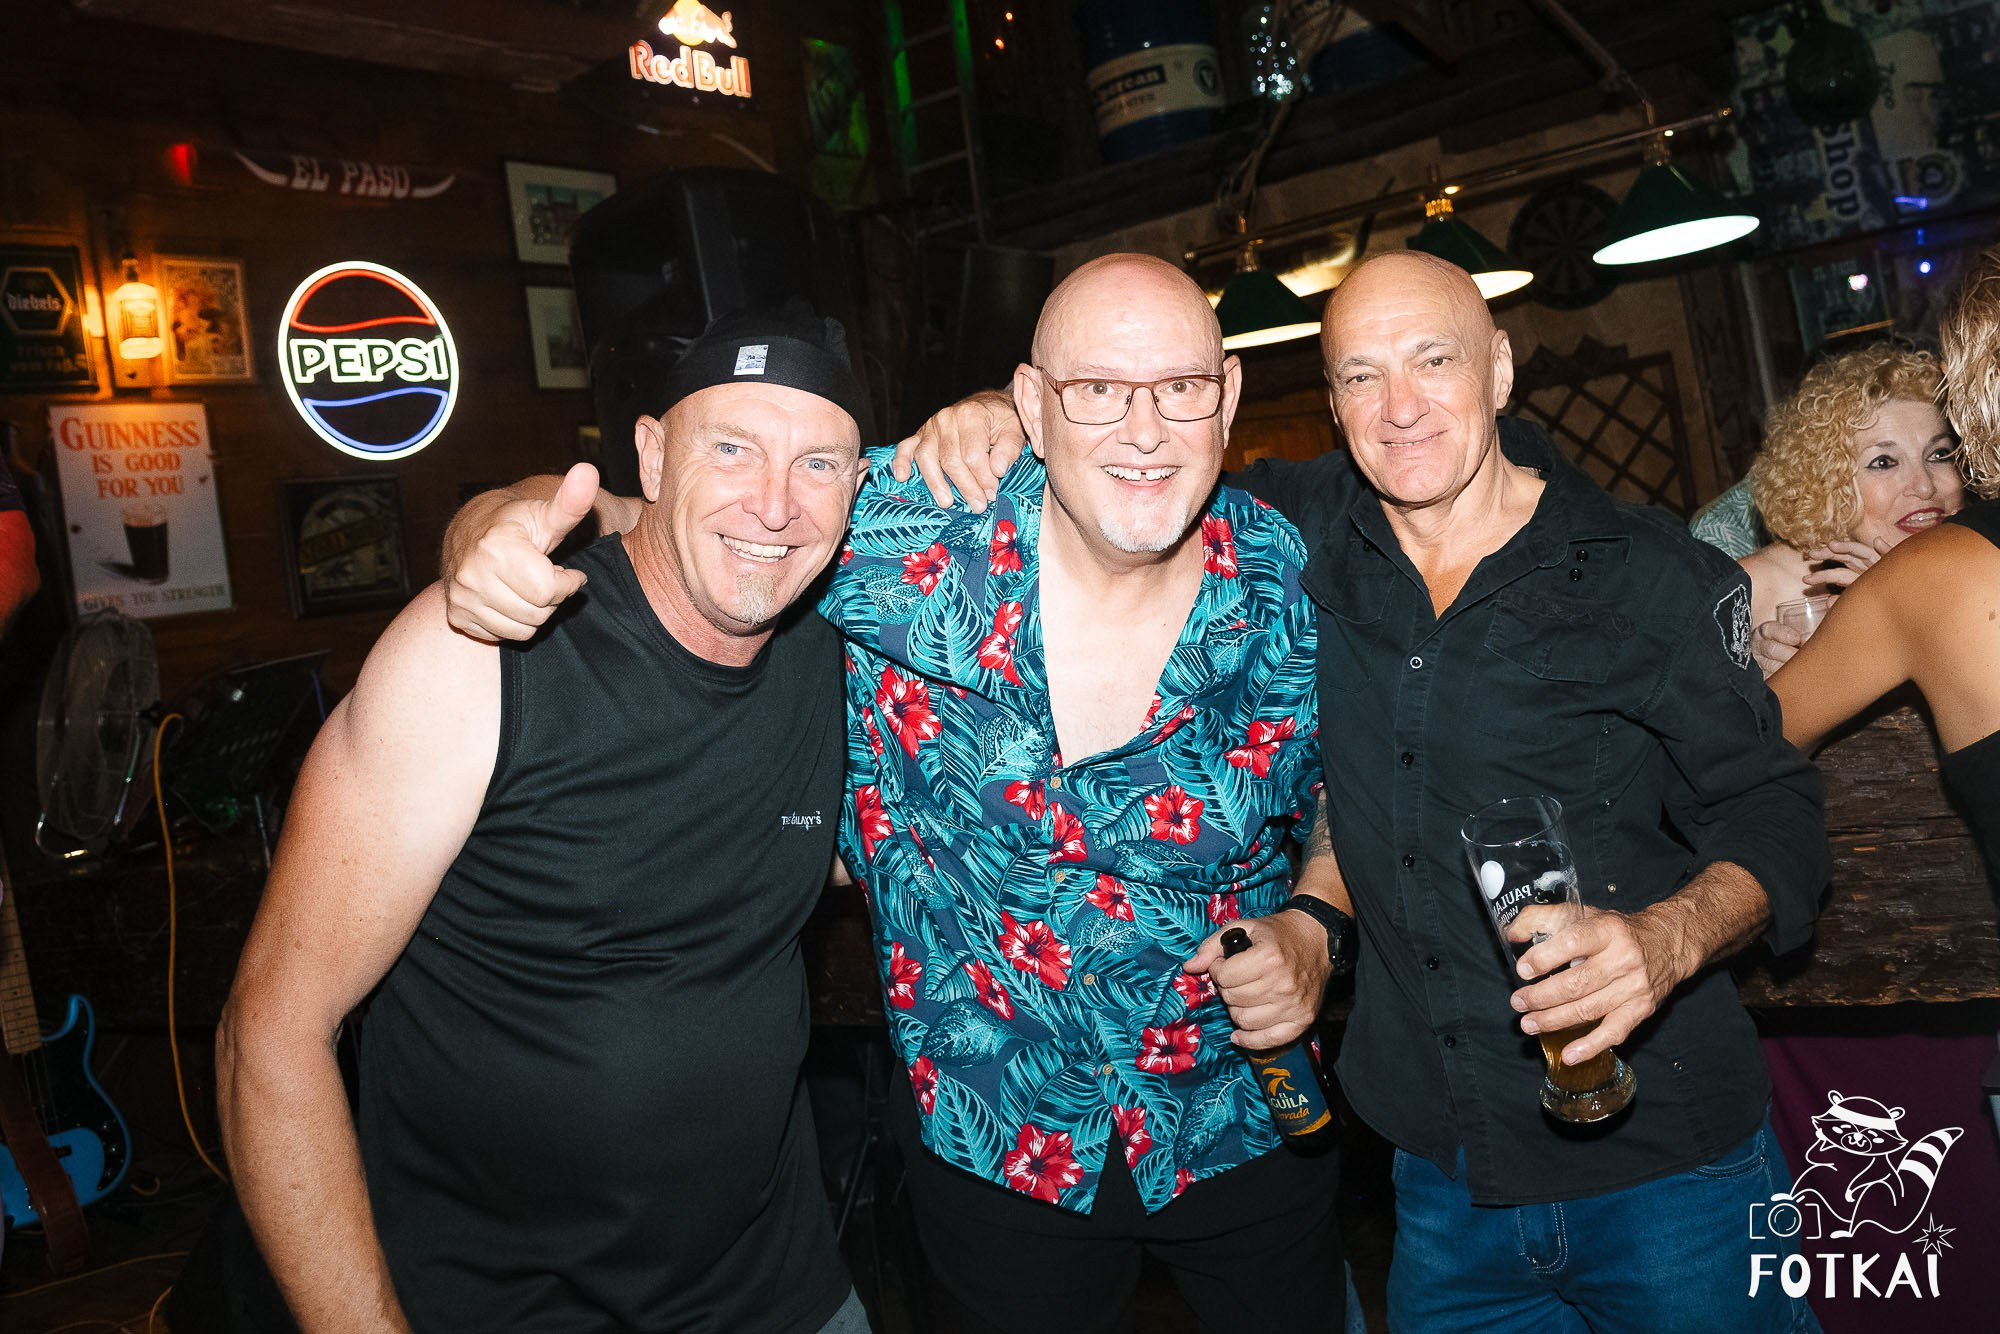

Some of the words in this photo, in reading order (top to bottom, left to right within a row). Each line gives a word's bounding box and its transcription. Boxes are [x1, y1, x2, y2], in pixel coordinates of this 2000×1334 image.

[290, 154, 331, 192] EL
[339, 159, 411, 198] PASO
[290, 338, 449, 383] PEPSI
[60, 417, 201, 450] GUINNESS
[92, 453, 113, 474] IS
[125, 452, 181, 472] GOOD
[97, 477, 138, 498] FOR
[144, 475, 184, 496] YOU
[1269, 1093, 1309, 1110] GUILA
[1280, 1107, 1310, 1120] orada
